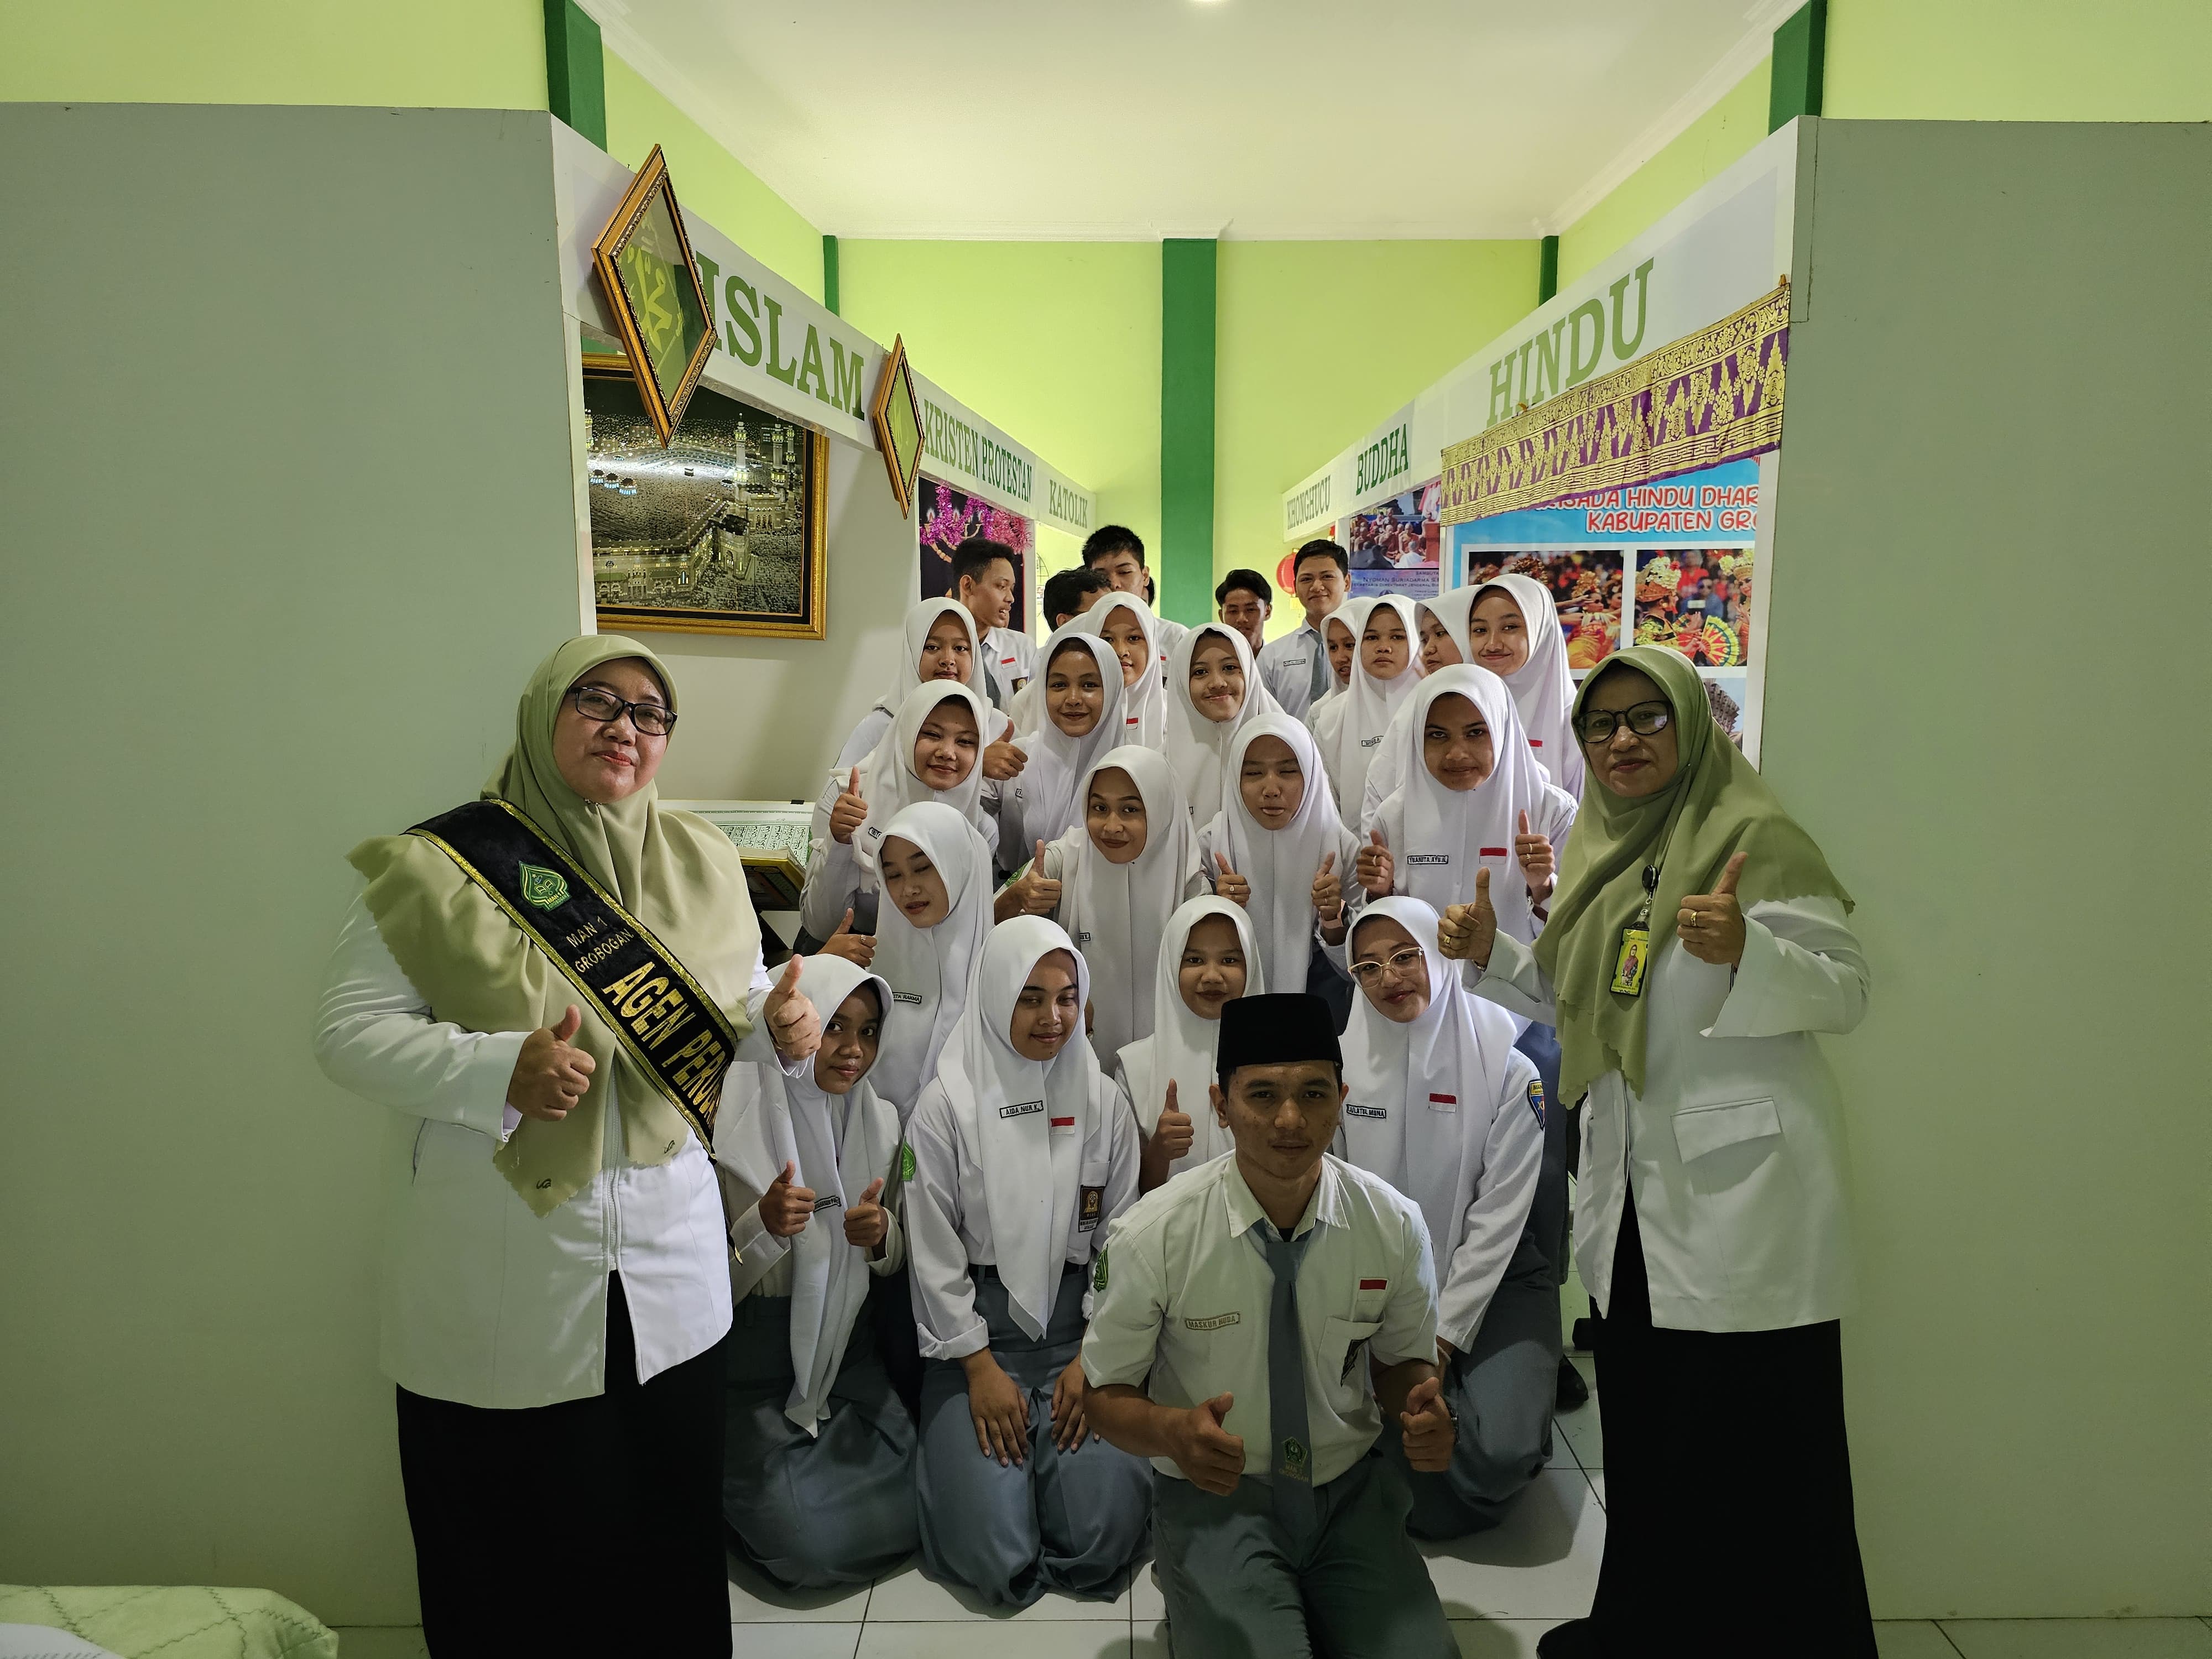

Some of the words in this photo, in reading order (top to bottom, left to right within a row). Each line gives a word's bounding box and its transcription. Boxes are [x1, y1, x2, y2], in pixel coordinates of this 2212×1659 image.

[696, 251, 865, 421] ISLAM
[1486, 257, 1654, 429] HINDU
[924, 399, 978, 478] KRISTEN
[982, 436, 1032, 503] PROTESTAN
[1356, 423, 1408, 495] BUDDHA
[1049, 479, 1088, 529] KATOLIK
[1287, 474, 1331, 530] KHONGHUCU
[1588, 510, 1712, 531] KABUPATEN
[1720, 510, 1756, 529] GR
[1627, 487, 1693, 507] HINDU
[566, 922, 598, 948] MAN
[597, 915, 608, 926] 1
[601, 961, 696, 1050] AGEN
[1006, 1107, 1019, 1115] AIDA
[1188, 1320, 1217, 1328] MASKUR
[1219, 1316, 1236, 1326] HUDA
